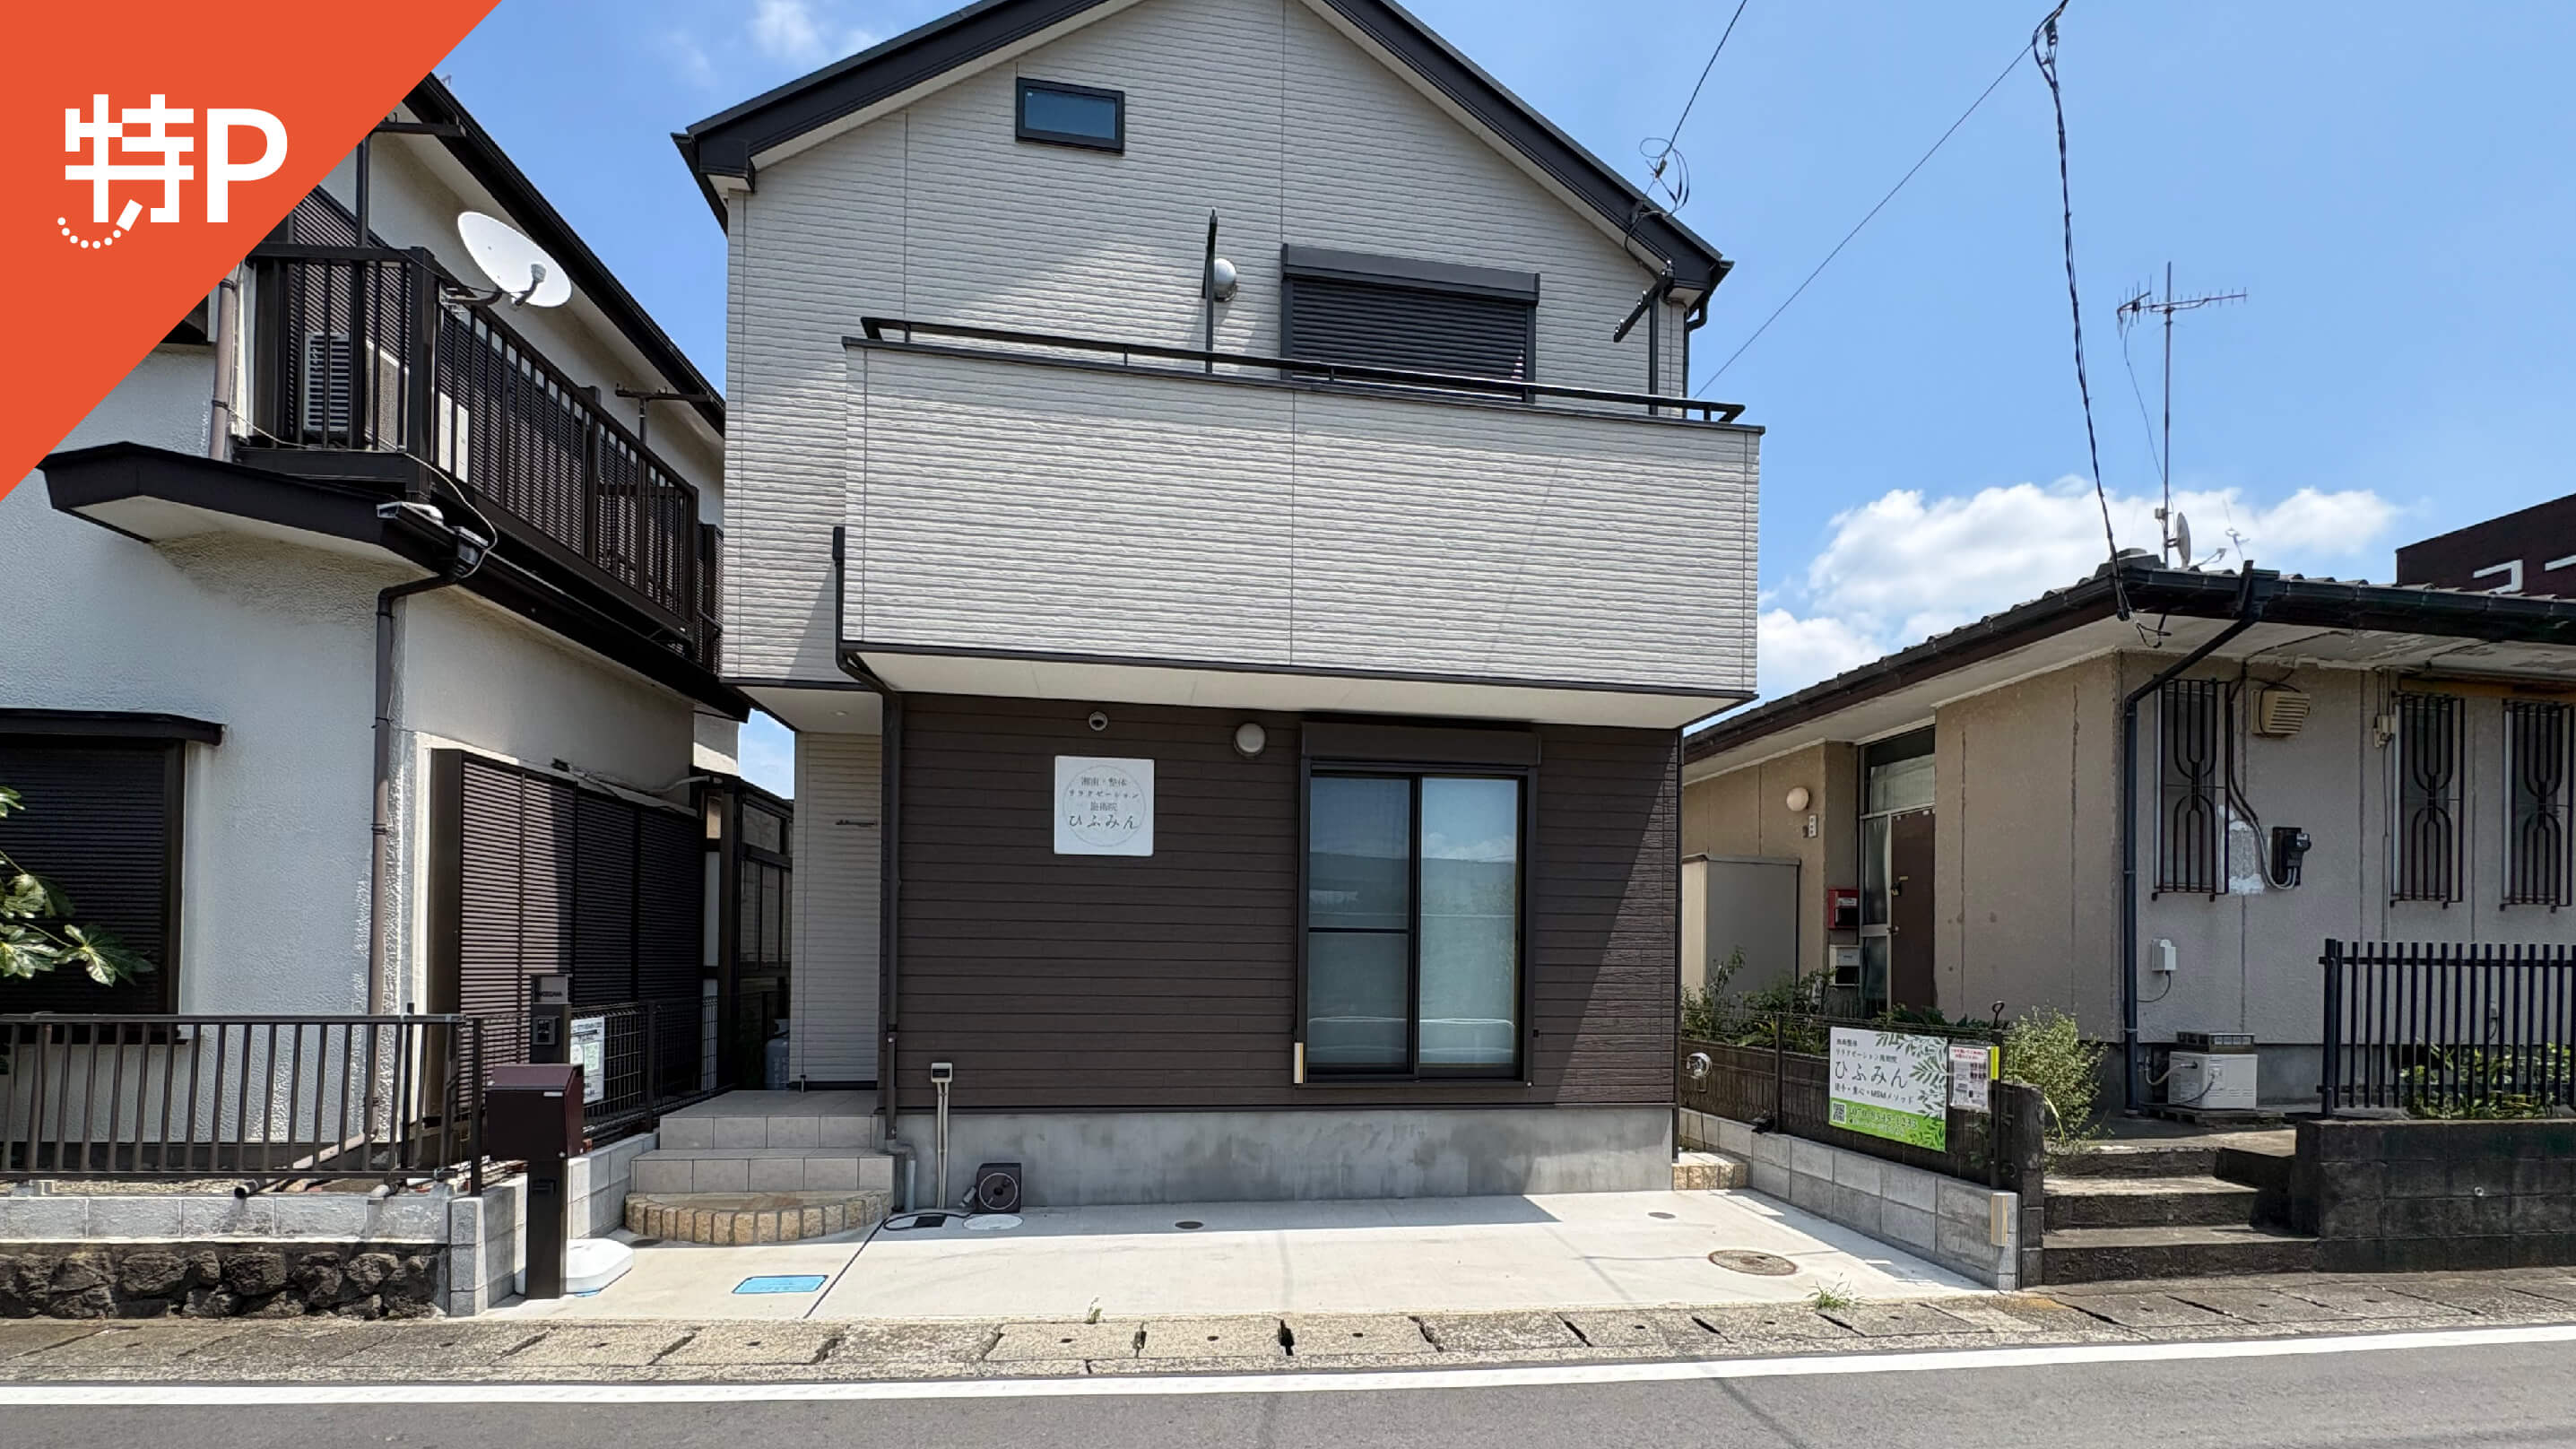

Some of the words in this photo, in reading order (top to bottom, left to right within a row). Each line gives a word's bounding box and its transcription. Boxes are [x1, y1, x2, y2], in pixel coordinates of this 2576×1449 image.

[1069, 814, 1141, 830] ひふみん
[1834, 1061, 1909, 1089] ひふみん
